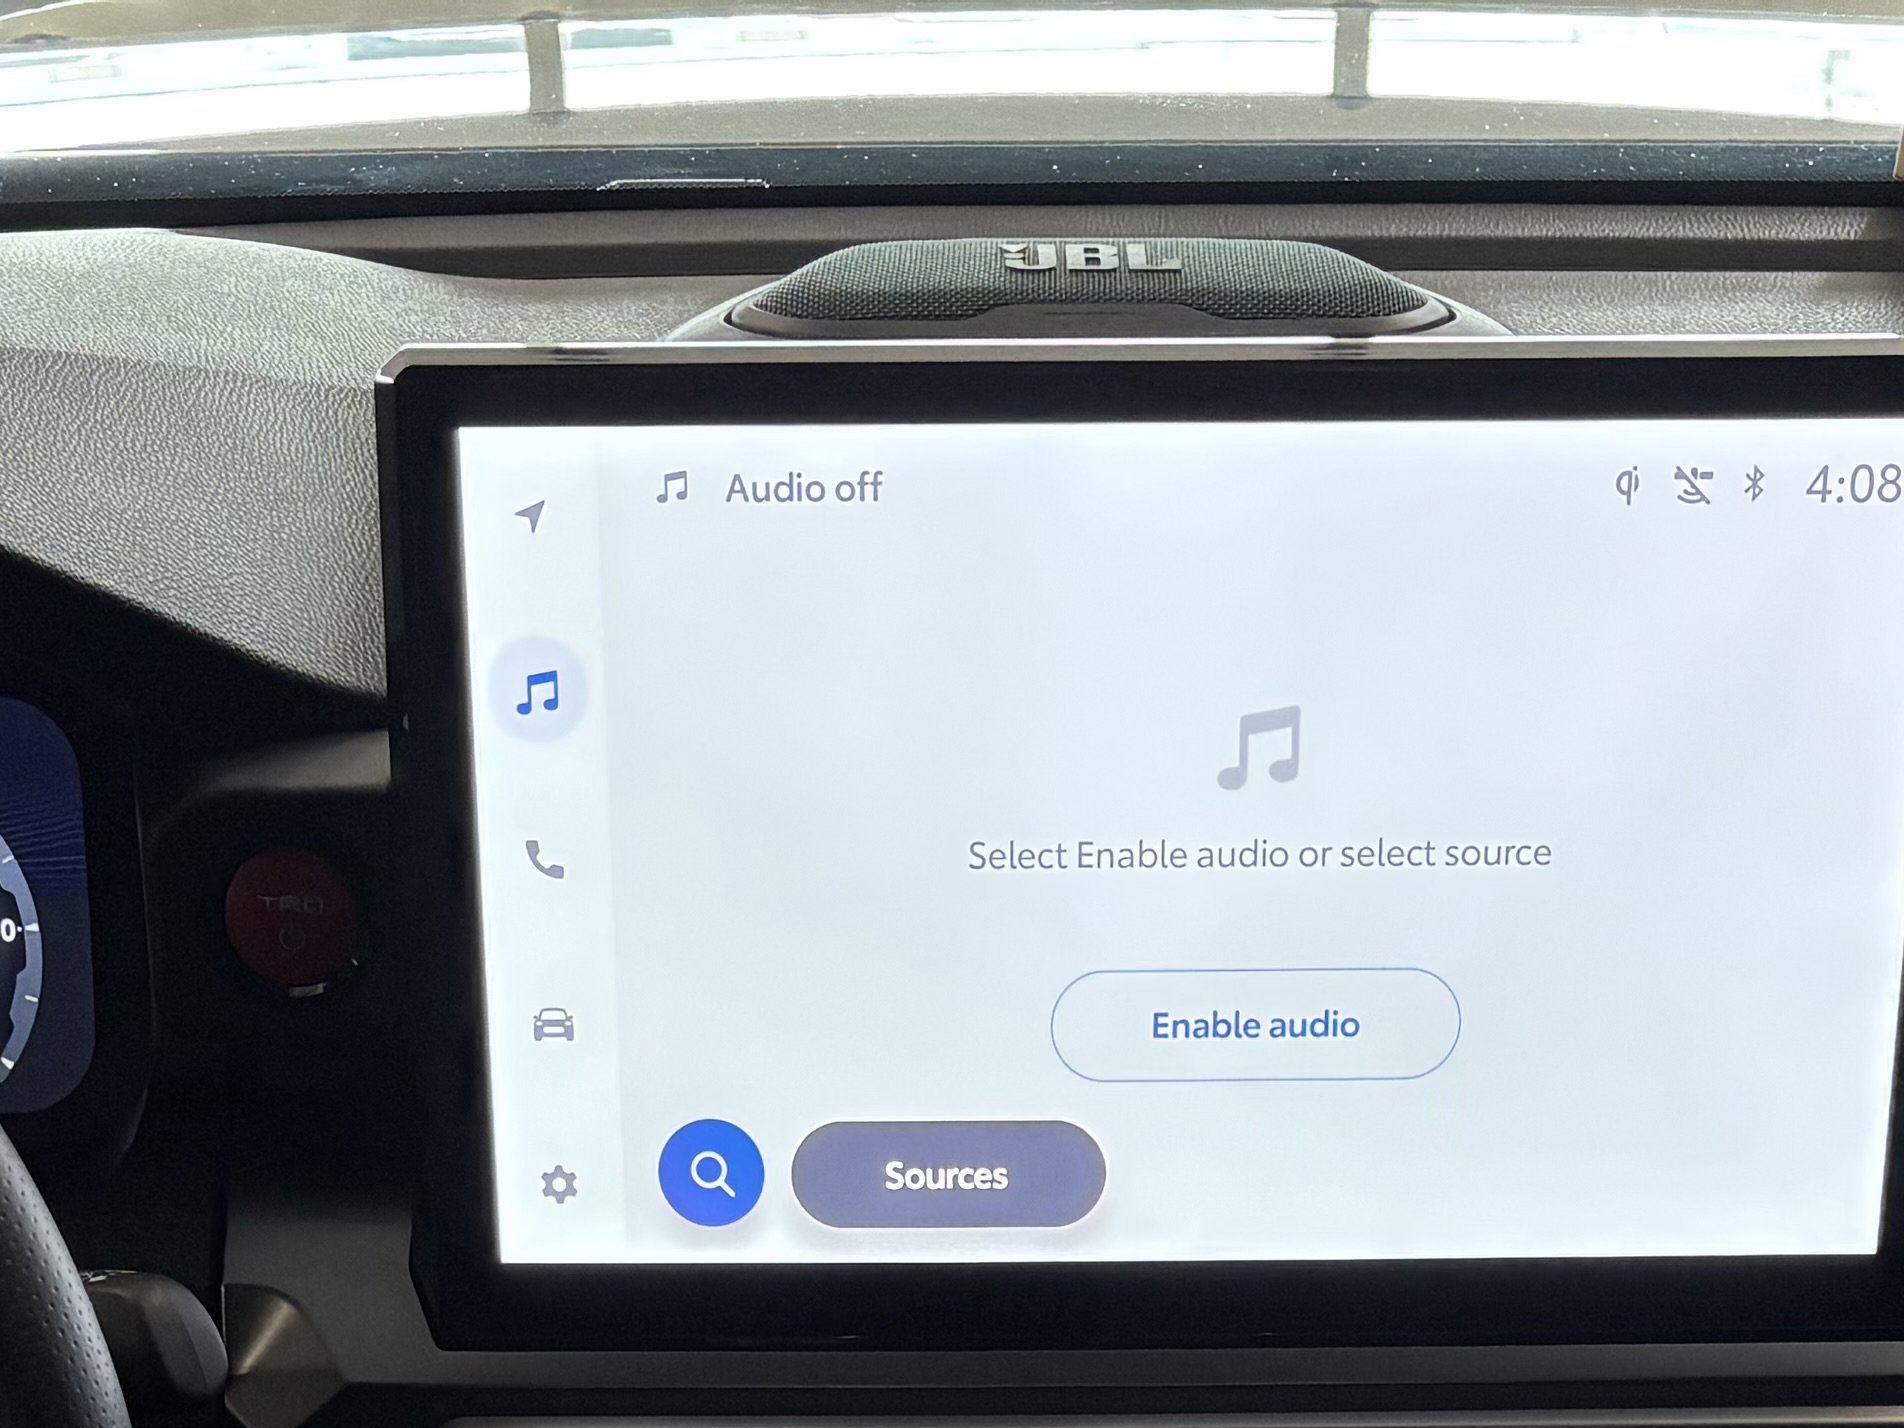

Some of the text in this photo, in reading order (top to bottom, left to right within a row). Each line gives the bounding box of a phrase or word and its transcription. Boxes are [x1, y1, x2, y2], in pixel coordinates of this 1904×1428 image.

[1001, 243, 1182, 271] JBL
[725, 471, 883, 503] Audio off
[1805, 463, 1903, 503] 4:08
[968, 838, 1553, 871] Select Enable audio or select source
[1151, 1009, 1361, 1041] Enable audio
[884, 1160, 1009, 1193] Sources
